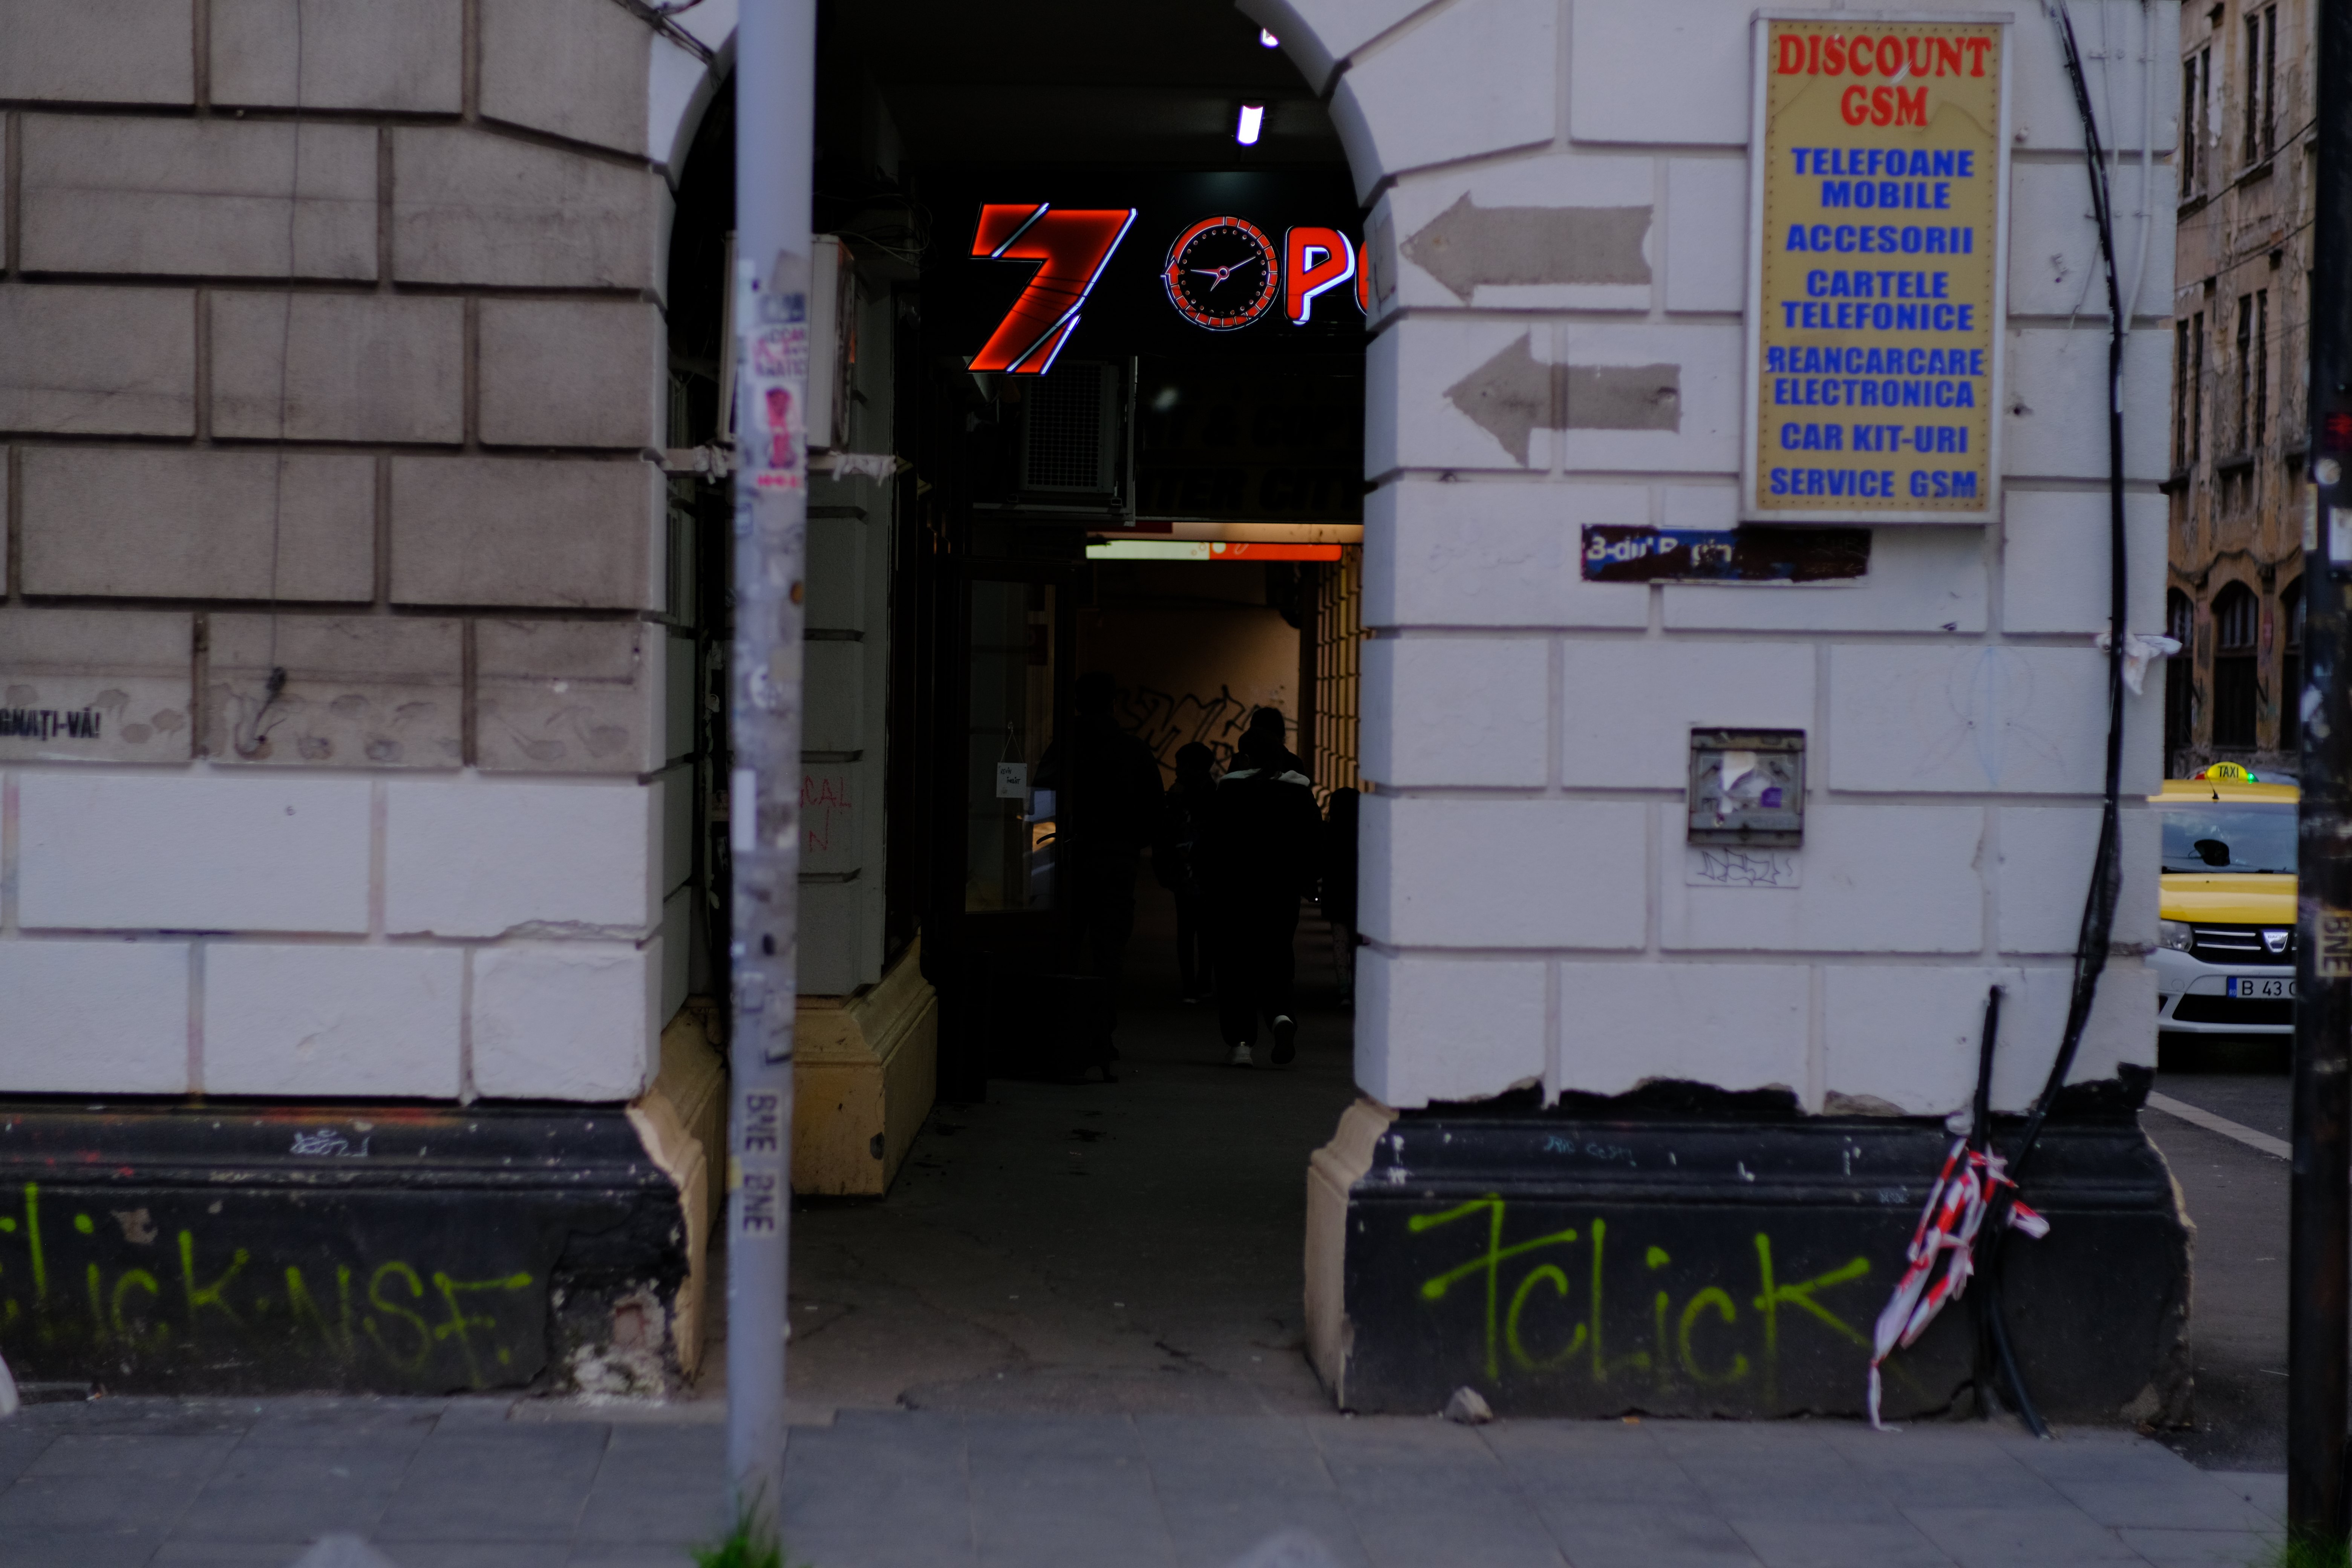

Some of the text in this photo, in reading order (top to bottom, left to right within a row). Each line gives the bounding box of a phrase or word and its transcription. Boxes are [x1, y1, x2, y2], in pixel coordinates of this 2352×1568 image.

[1778, 34, 1992, 77] DISCOUNT
[1841, 84, 1929, 127] GSM
[1791, 147, 1975, 178] TELEFOANE
[1821, 181, 1951, 210] MOBILE
[1785, 224, 1974, 254] ACCESORII
[1806, 269, 1949, 299] CARTELE
[1781, 300, 1975, 331] TELEFONICE
[1766, 345, 1984, 377] REANCARCARE
[1774, 378, 1976, 409] ELECTRONICA
[1780, 422, 1969, 453] CAR KIT-URI
[1769, 467, 1977, 499] SERVICE GSM
[2217, 765, 2239, 778] TAXI
[2242, 980, 2254, 995] B
[2262, 981, 2282, 996] 43
